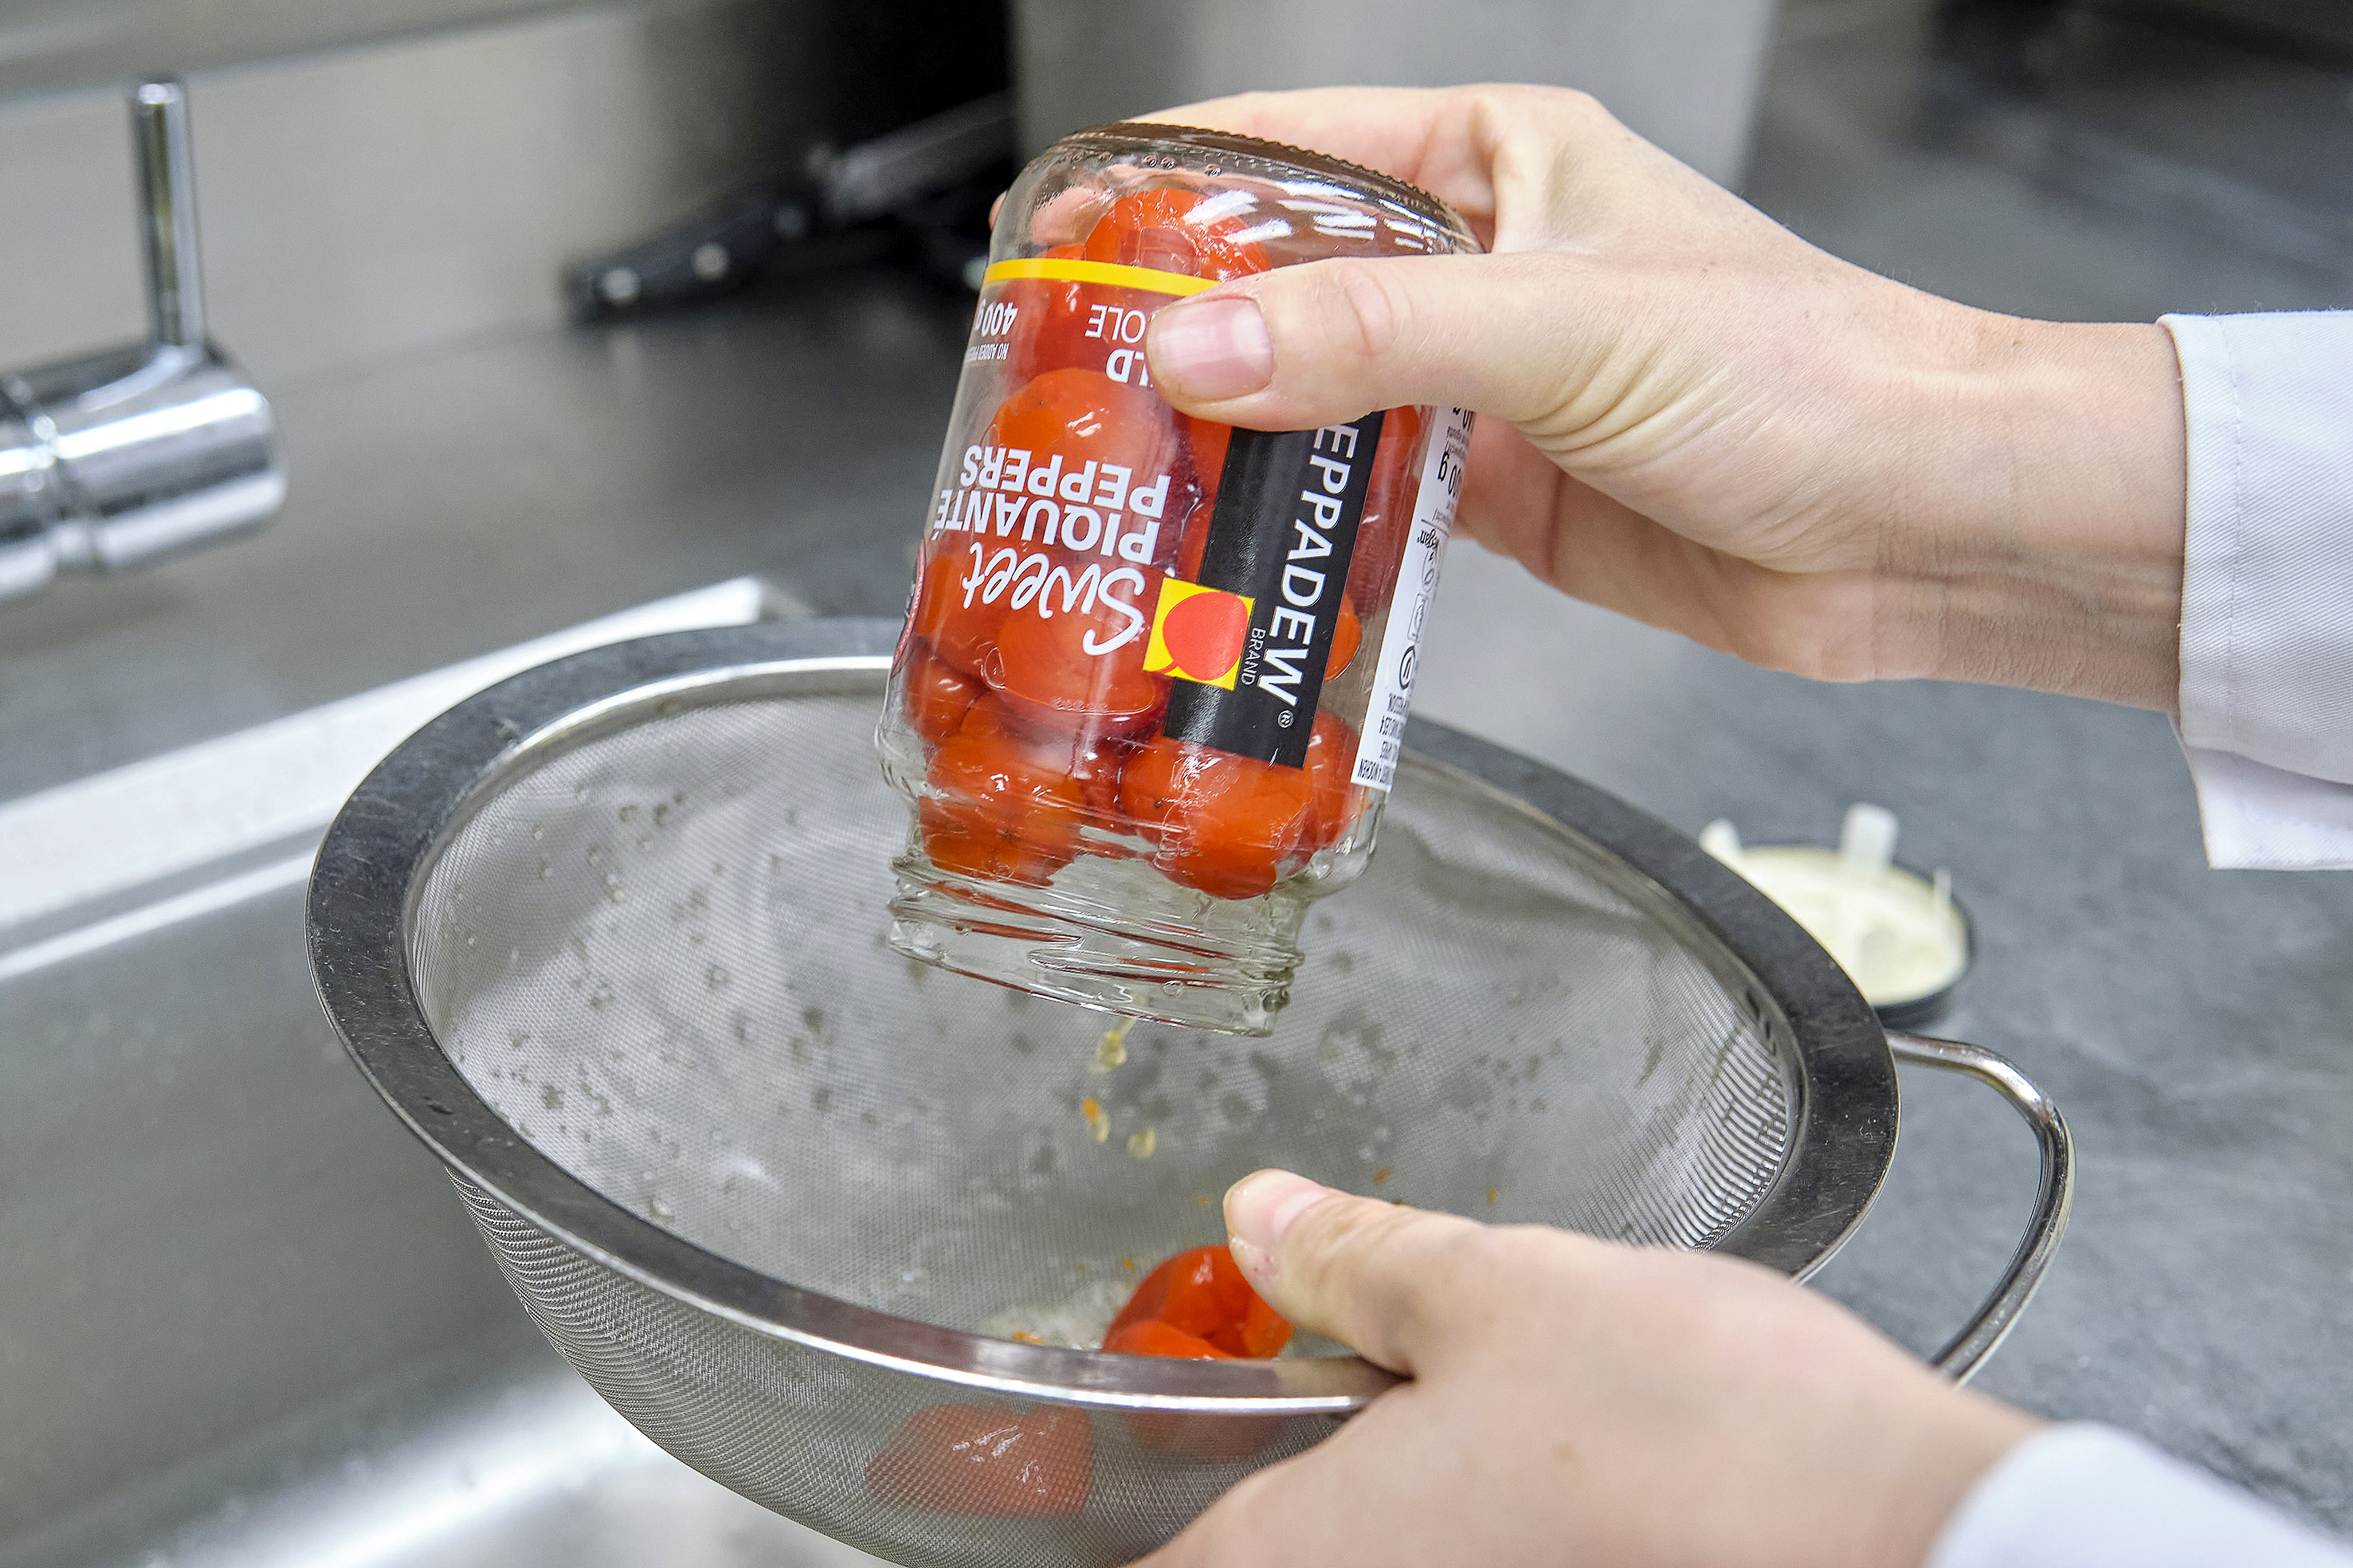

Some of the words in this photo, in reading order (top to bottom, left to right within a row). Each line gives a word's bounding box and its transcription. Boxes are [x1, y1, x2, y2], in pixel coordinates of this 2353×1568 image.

[1084, 304, 1156, 343] OLE
[1106, 348, 1154, 388] LD
[960, 445, 1172, 519] PEPPERS
[931, 488, 1161, 566] PIQUANTÉ
[962, 542, 1146, 656] Sweet
[1257, 425, 1359, 707] EPPADEW
[1241, 627, 1267, 686] BRAND
